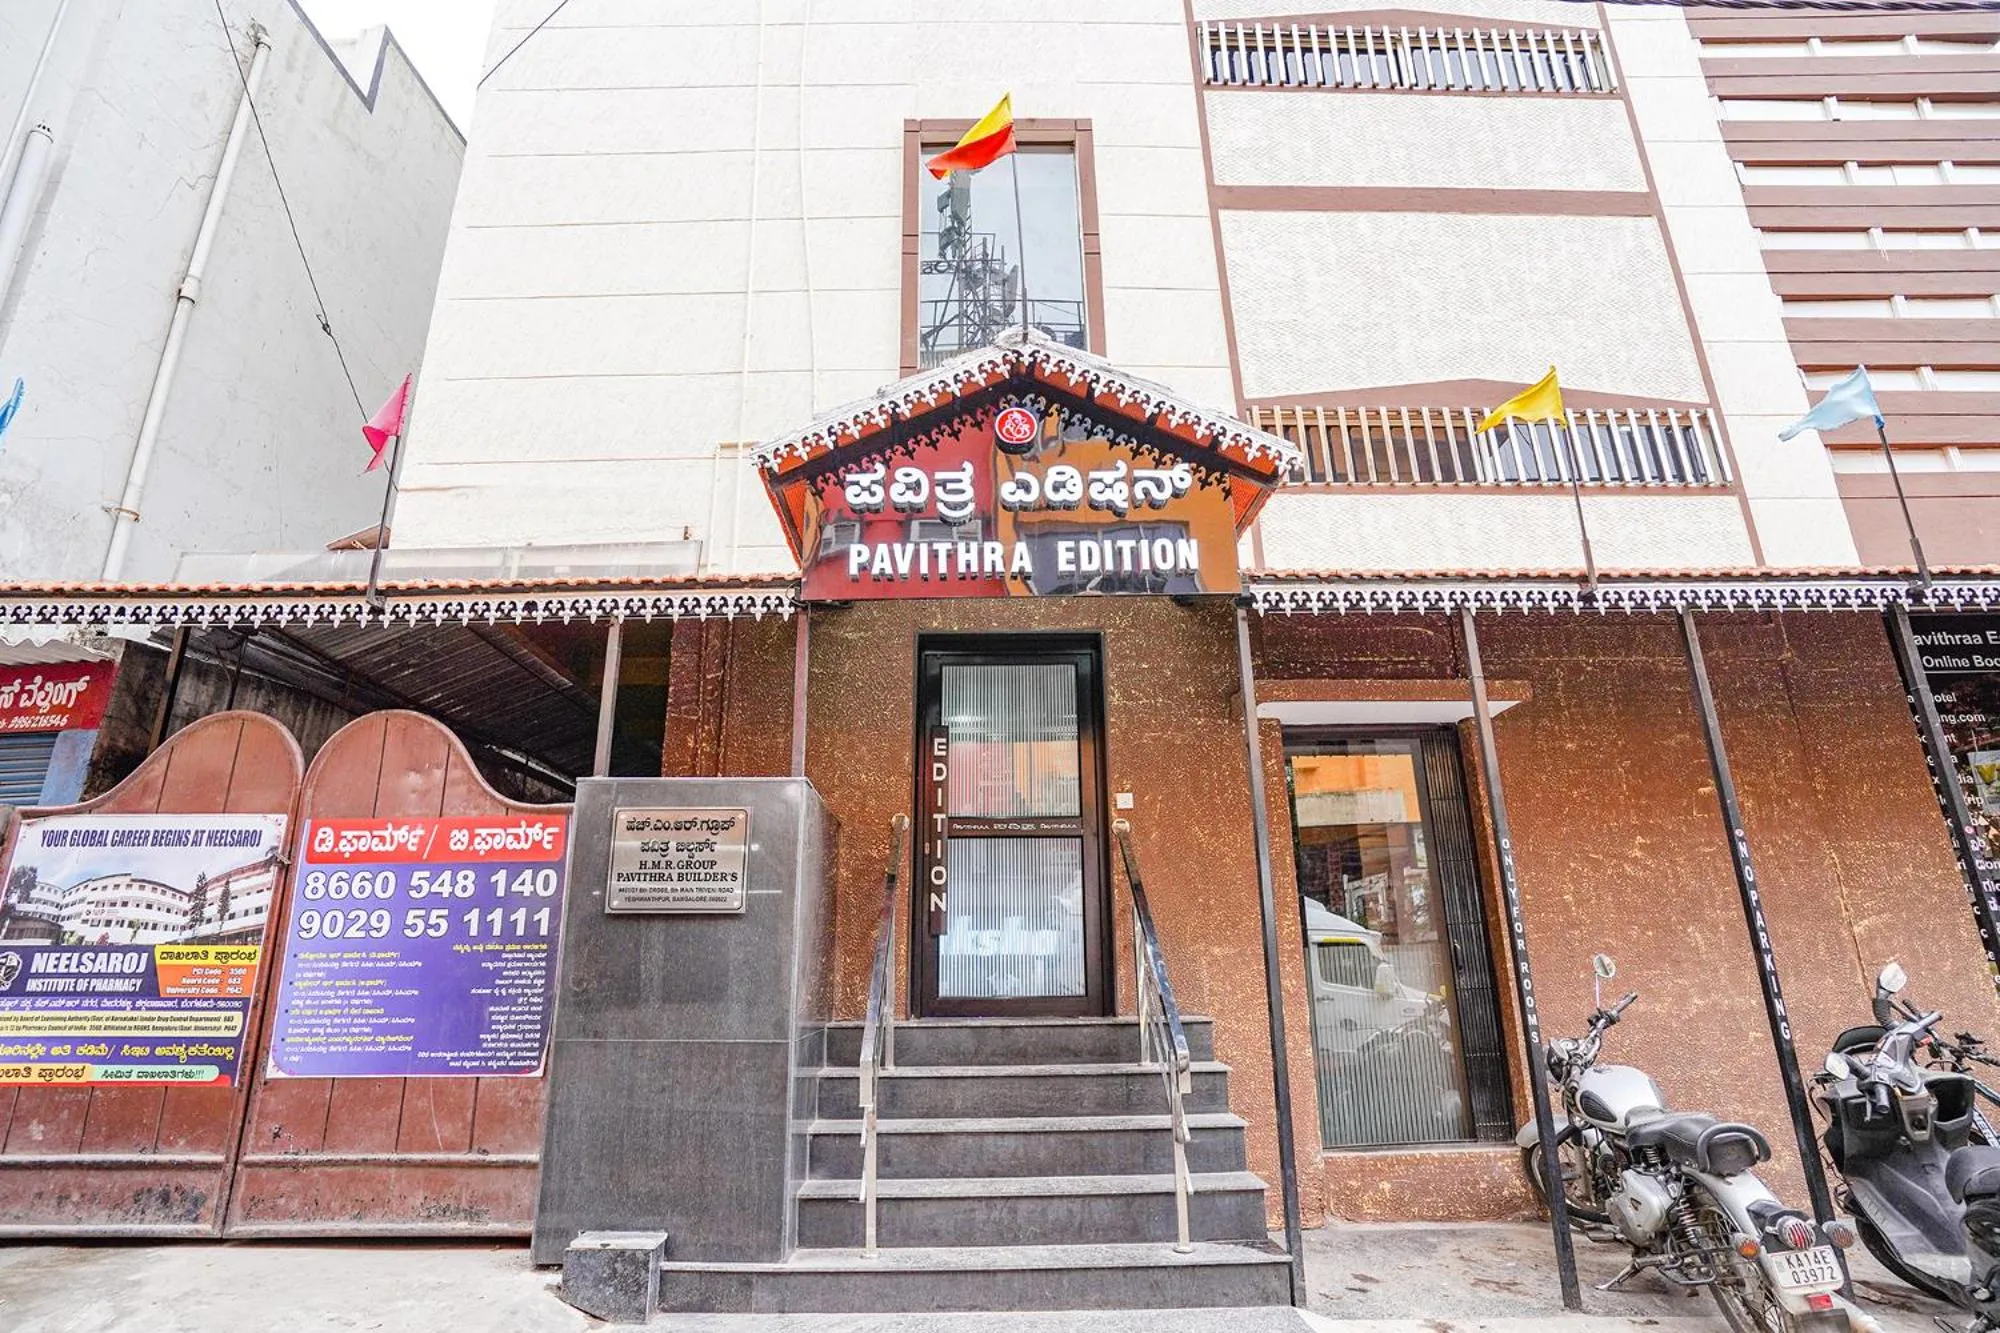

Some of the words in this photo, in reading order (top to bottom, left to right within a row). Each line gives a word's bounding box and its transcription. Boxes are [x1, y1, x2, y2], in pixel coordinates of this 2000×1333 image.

[845, 461, 975, 520] ಪವಿತ್ರ
[1001, 459, 1192, 512] ಎಡಿಷನ್
[849, 541, 1032, 577] PAVITHRA
[1057, 538, 1199, 572] EDITION
[1913, 631, 1983, 646] avithraa
[1986, 630, 2000, 645] E
[1922, 655, 1970, 669] Online
[41, 829, 68, 847] YOUR
[69, 829, 108, 847] GLOBAL
[110, 829, 150, 847] CAREER
[150, 829, 189, 847] BEGINS
[190, 829, 203, 847] AT
[205, 829, 262, 847] NEELSAROJ
[930, 738, 948, 912] EDITION
[303, 869, 397, 900] 8660
[408, 869, 476, 899] 548
[490, 868, 558, 898] 140
[616, 872, 673, 882] PAVITHRA
[677, 872, 738, 882] BUILDER'S
[298, 908, 392, 940] 9029
[403, 907, 449, 938] 55
[462, 907, 551, 938] 1111
[1502, 838, 1517, 900] ONLY
[1513, 906, 1526, 950] FOR
[1520, 962, 1539, 1043] ROOMS
[1738, 842, 1754, 882] NO
[1750, 890, 1791, 1040] PARKING
[30, 952, 148, 974] NEELSAROJ
[26, 978, 75, 992] INSTITUTE
[76, 978, 88, 992] OF
[88, 978, 143, 992] PHARMACY
